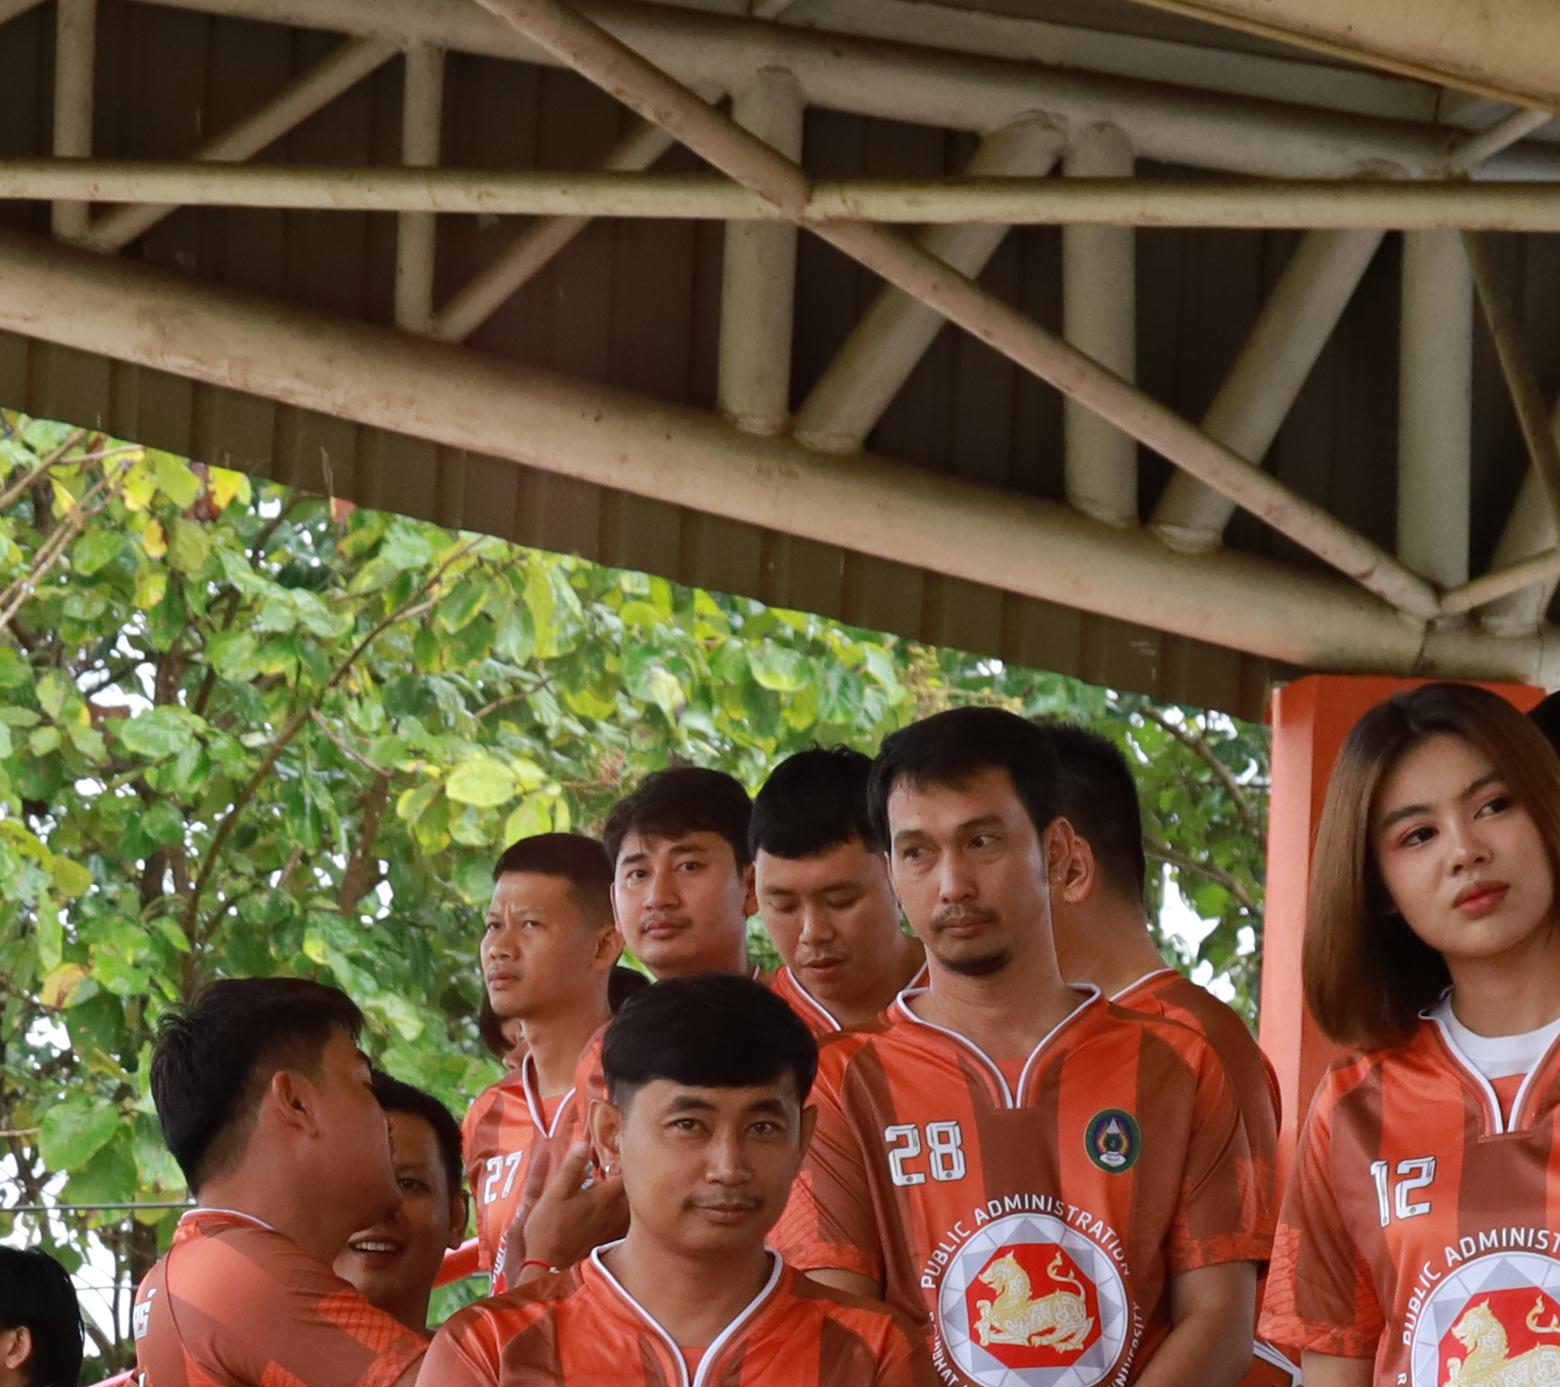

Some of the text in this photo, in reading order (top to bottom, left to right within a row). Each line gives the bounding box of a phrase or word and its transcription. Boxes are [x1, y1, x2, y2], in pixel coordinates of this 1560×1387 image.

[484, 1150, 523, 1205] 27
[884, 1121, 966, 1186] 28
[1370, 1156, 1436, 1228] 12
[921, 1194, 1130, 1289] PUBLIC ADMINISTRATION
[1402, 1262, 1441, 1346] PUBLIC
